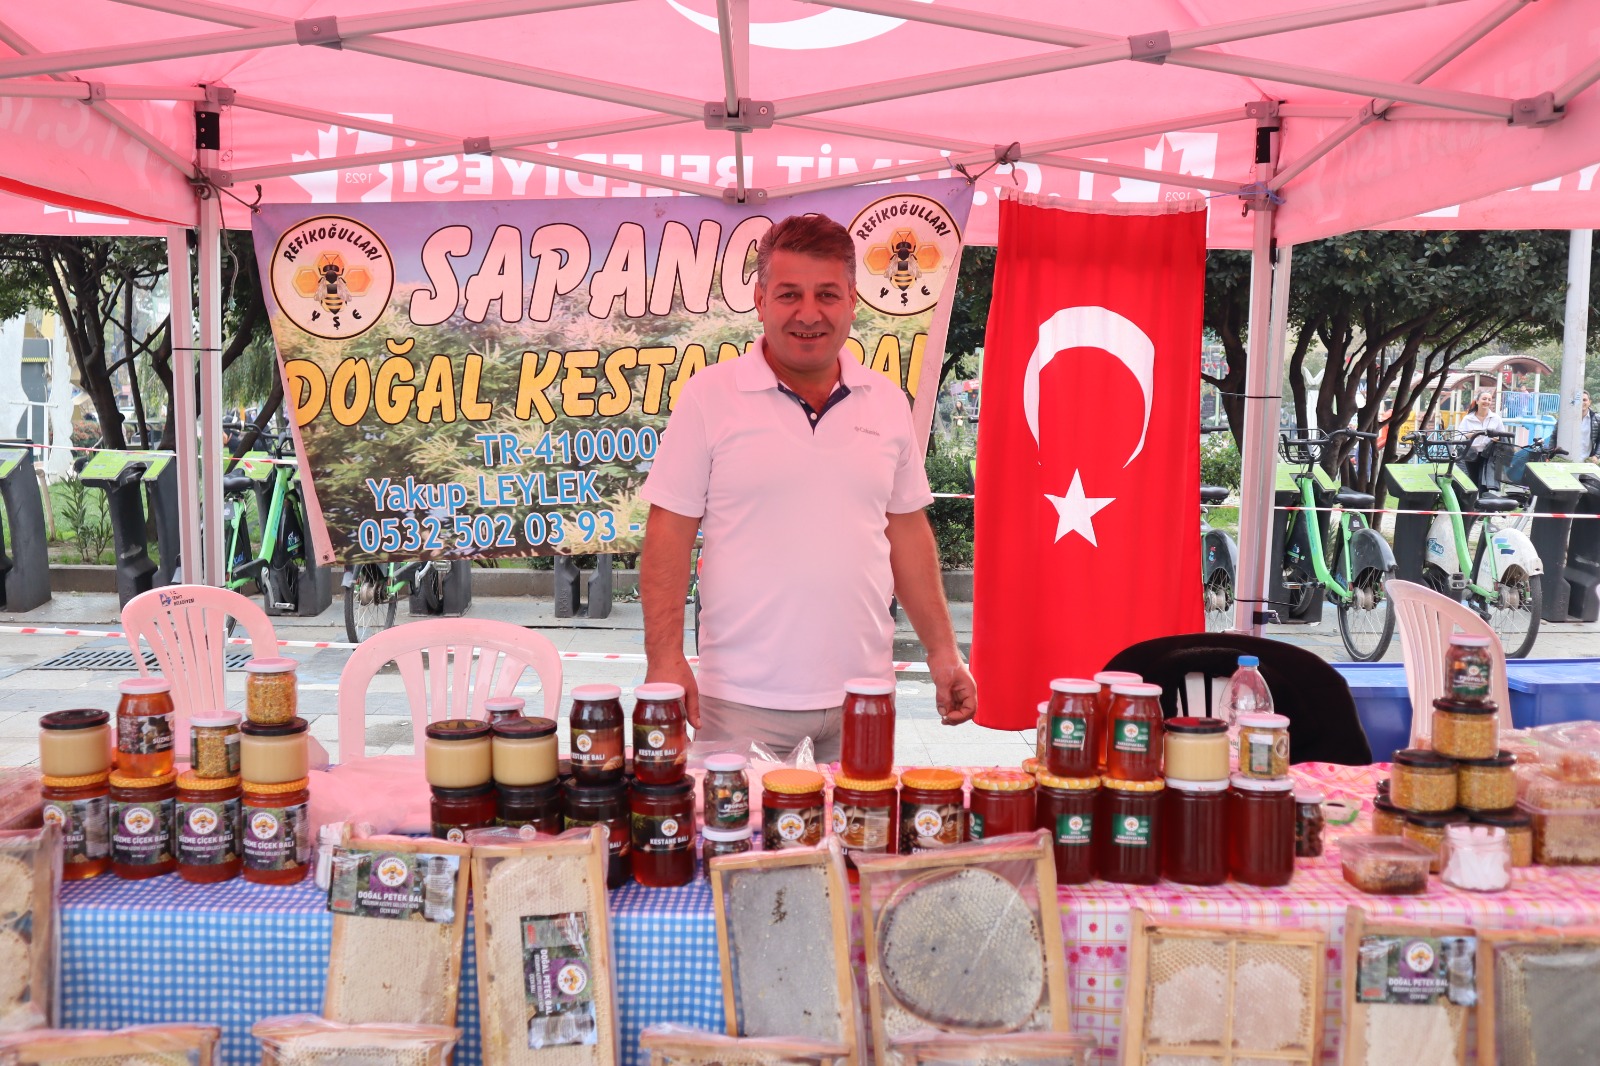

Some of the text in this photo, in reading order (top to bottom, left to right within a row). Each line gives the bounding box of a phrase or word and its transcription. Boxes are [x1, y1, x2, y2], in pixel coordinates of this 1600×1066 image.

[856, 200, 951, 240] REFİKOĞULLARI
[283, 223, 383, 263] REFİKOĞULLARI
[409, 212, 775, 326] SAPANC
[284, 338, 493, 426] DOĞAL
[476, 426, 664, 467] TR-410000
[366, 470, 603, 517] Yakup LEYLEK
[357, 516, 444, 552] 0532
[454, 514, 517, 549] 502
[523, 511, 566, 545] 03
[577, 510, 618, 543] 93
[638, 748, 676, 757] KESTANE BALI
[258, 839, 278, 850] ÇİÇEK
[278, 840, 294, 849] BALI
[358, 890, 382, 900] DOĞAL
[383, 892, 408, 902] PETEK
[540, 949, 553, 1016] DOĞAL PETEK BAL
